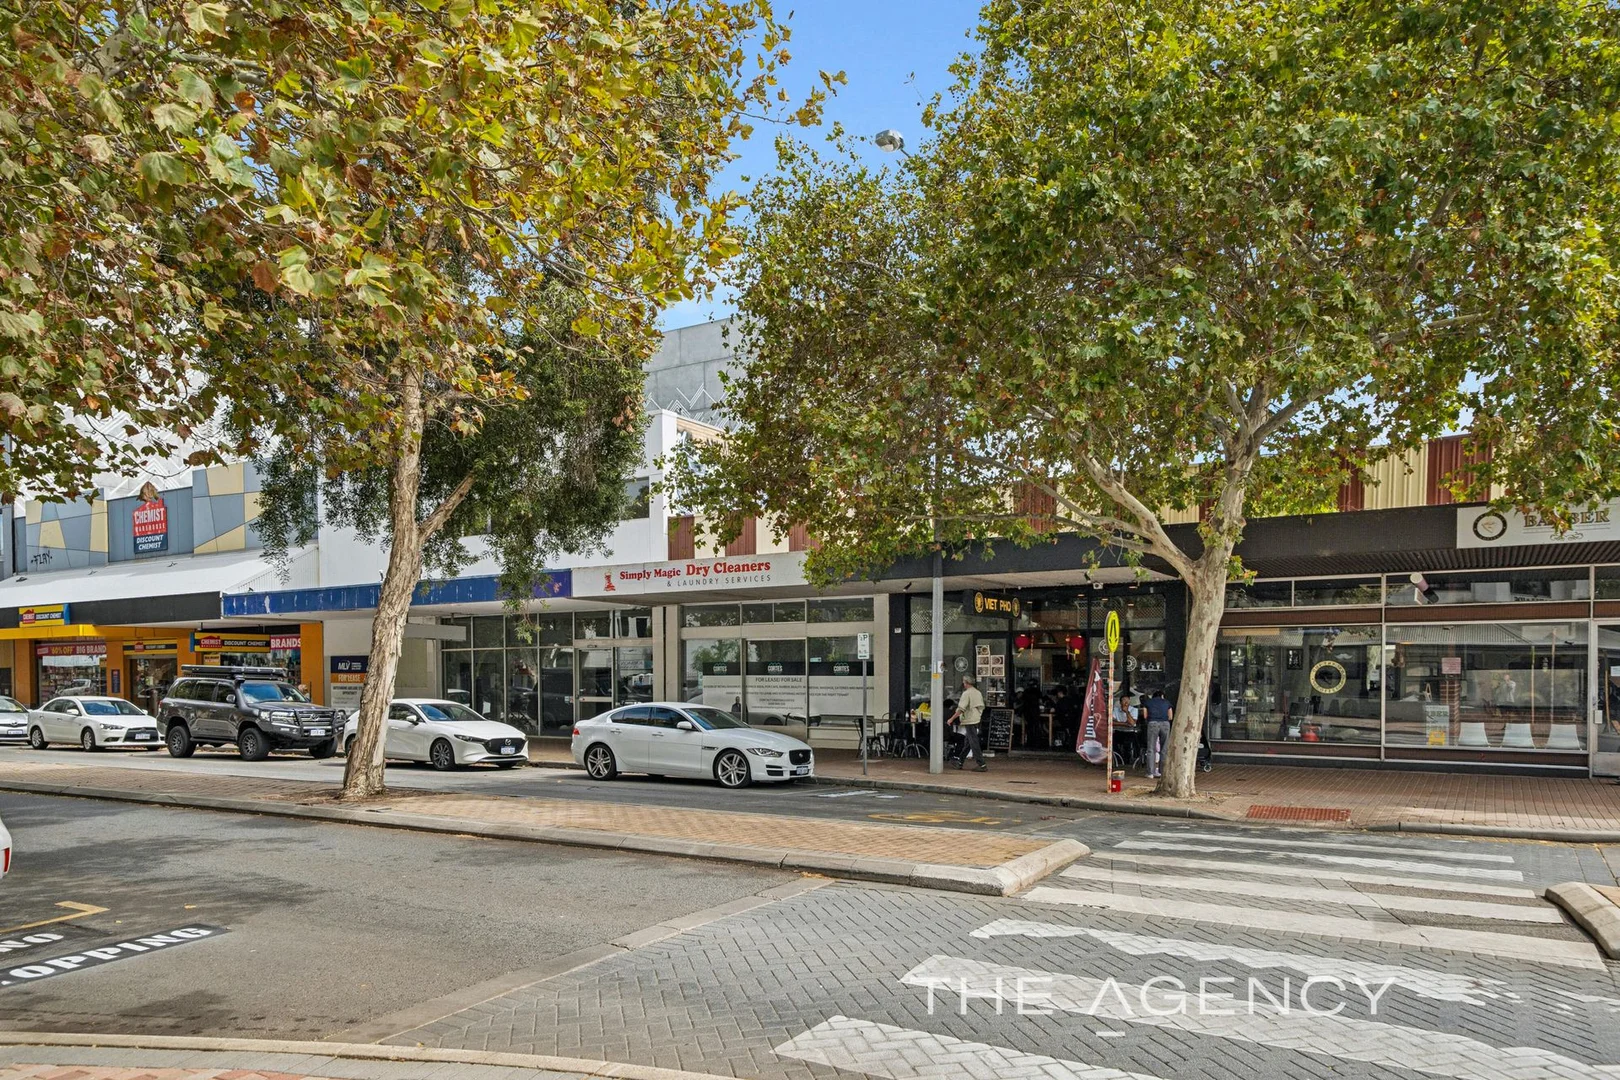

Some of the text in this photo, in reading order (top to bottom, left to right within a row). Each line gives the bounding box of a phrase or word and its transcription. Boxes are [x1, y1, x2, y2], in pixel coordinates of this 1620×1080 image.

[134, 508, 165, 524] CHEMIST
[1524, 511, 1611, 528] BABER
[136, 535, 164, 544] DISCOUNT
[138, 542, 162, 550] CHEMIST
[620, 561, 771, 581] Simply Magic Dry Cleaners
[677, 578, 719, 586] LAUNDRY
[725, 575, 771, 584] SERVICES
[984, 598, 1012, 612] VIET PHO
[76, 645, 86, 653] BIG
[338, 662, 350, 670] MLV
[0, 933, 64, 953] NO
[1, 927, 213, 986] OPPING
